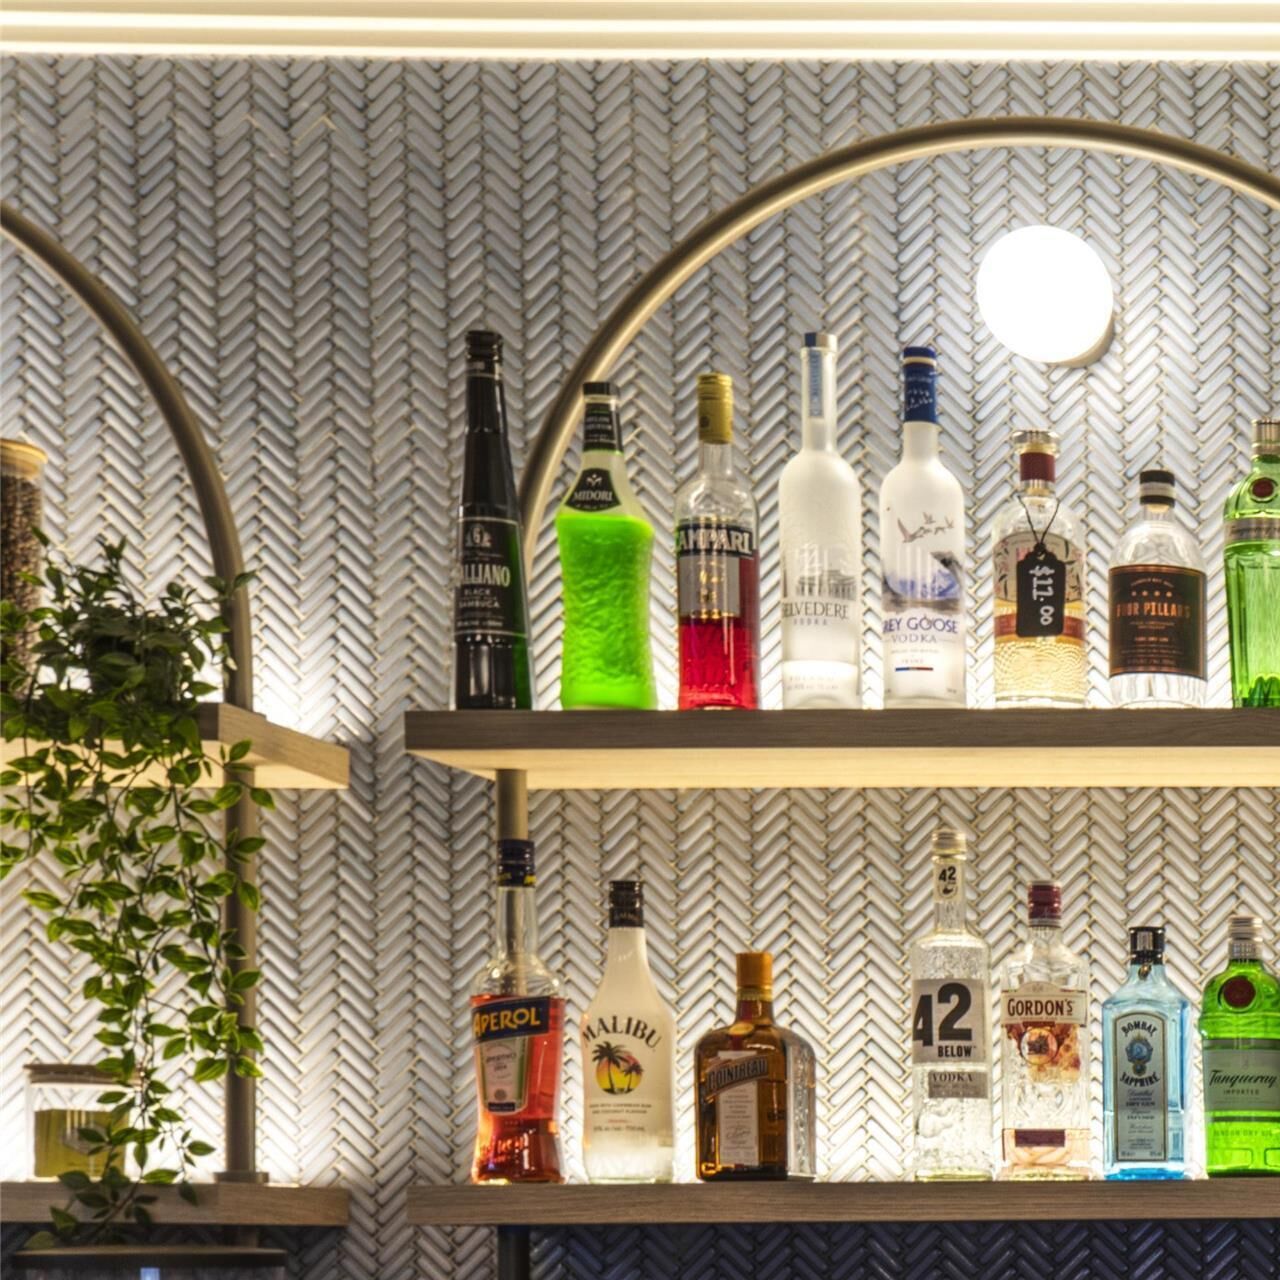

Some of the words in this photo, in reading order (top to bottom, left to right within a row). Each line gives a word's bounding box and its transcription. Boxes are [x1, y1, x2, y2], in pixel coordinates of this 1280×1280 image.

[573, 489, 614, 502] MIDORI
[1028, 564, 1056, 626] $11.00
[906, 614, 959, 633] GOOSE
[891, 633, 938, 644] VODKA
[937, 866, 957, 883] 42
[912, 982, 974, 1047] 42
[1007, 998, 1074, 1017] GORDON'S
[472, 1007, 542, 1037] APEROL
[582, 1015, 662, 1048] MALIBU
[1120, 1020, 1158, 1037] BOMBAY
[937, 1045, 972, 1058] BELOW
[1120, 1071, 1160, 1088] SAPPHIRE
[1208, 1069, 1278, 1089] Tanqueray
